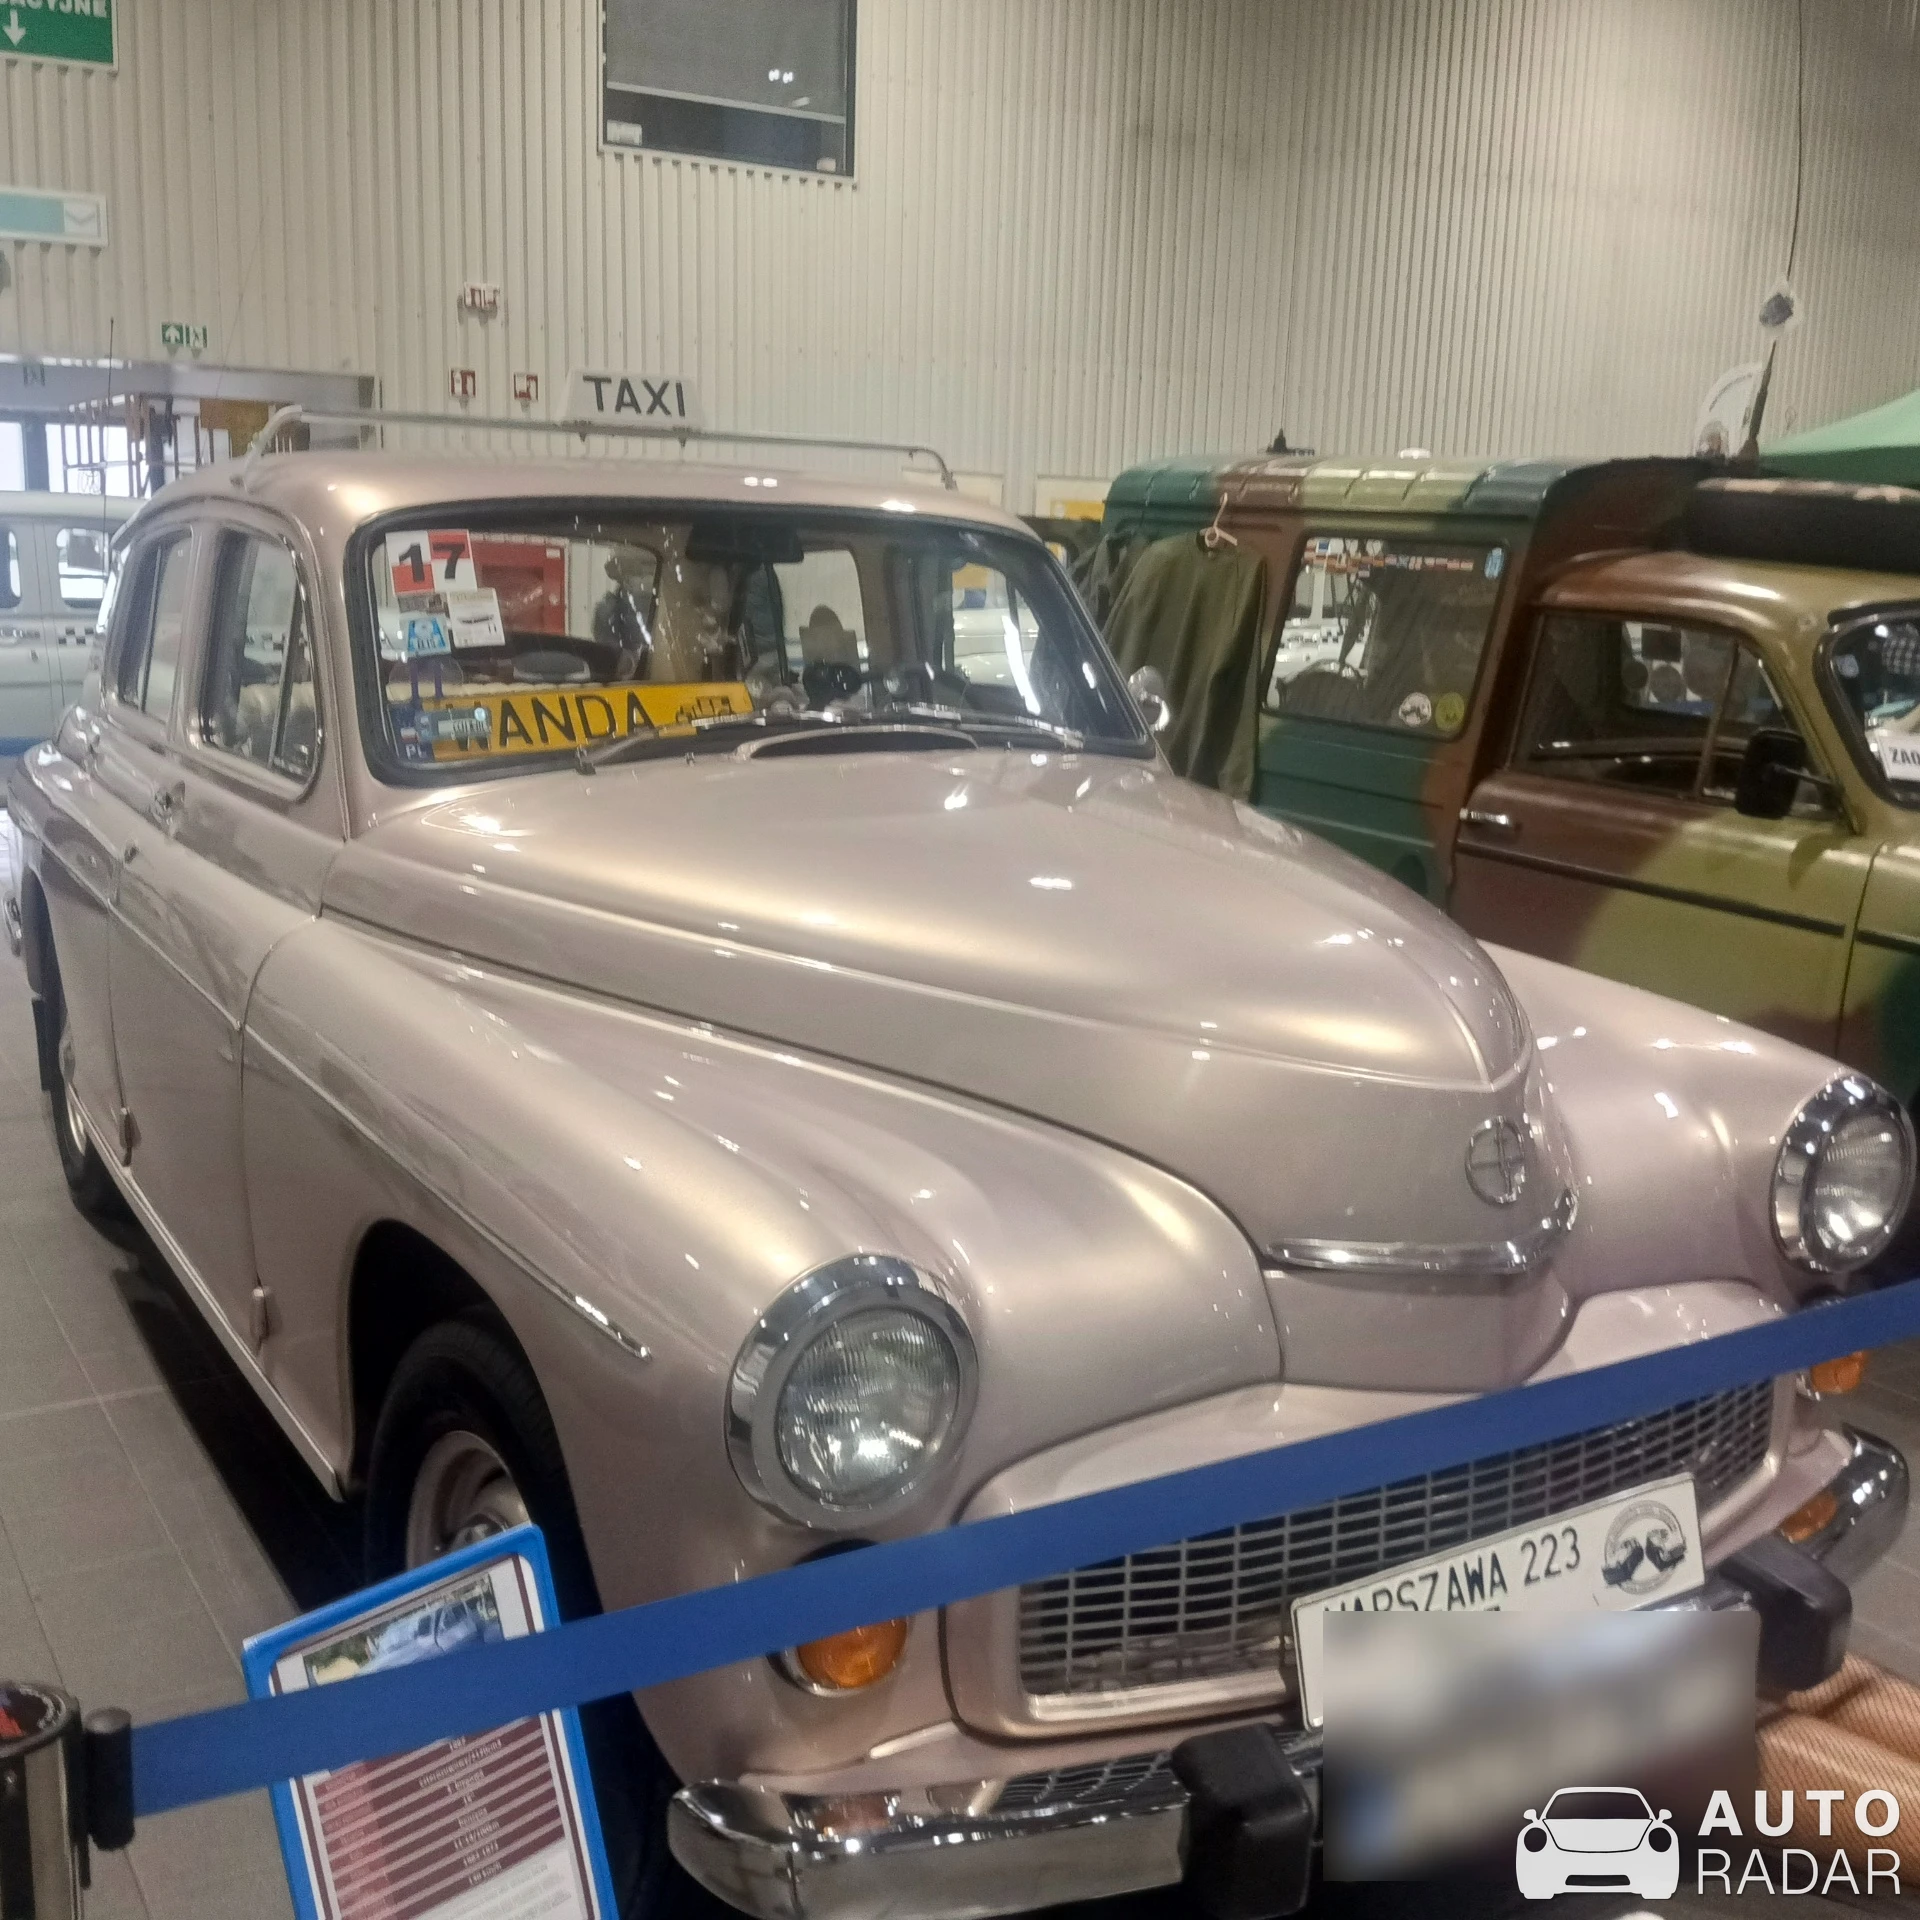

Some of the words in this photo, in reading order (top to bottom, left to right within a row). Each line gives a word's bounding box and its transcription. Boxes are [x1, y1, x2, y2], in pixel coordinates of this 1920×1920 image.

[582, 375, 685, 417] TAXI
[399, 543, 466, 583] 17
[1324, 1551, 1508, 1611] RSZAWA
[1521, 1526, 1581, 1586] 223
